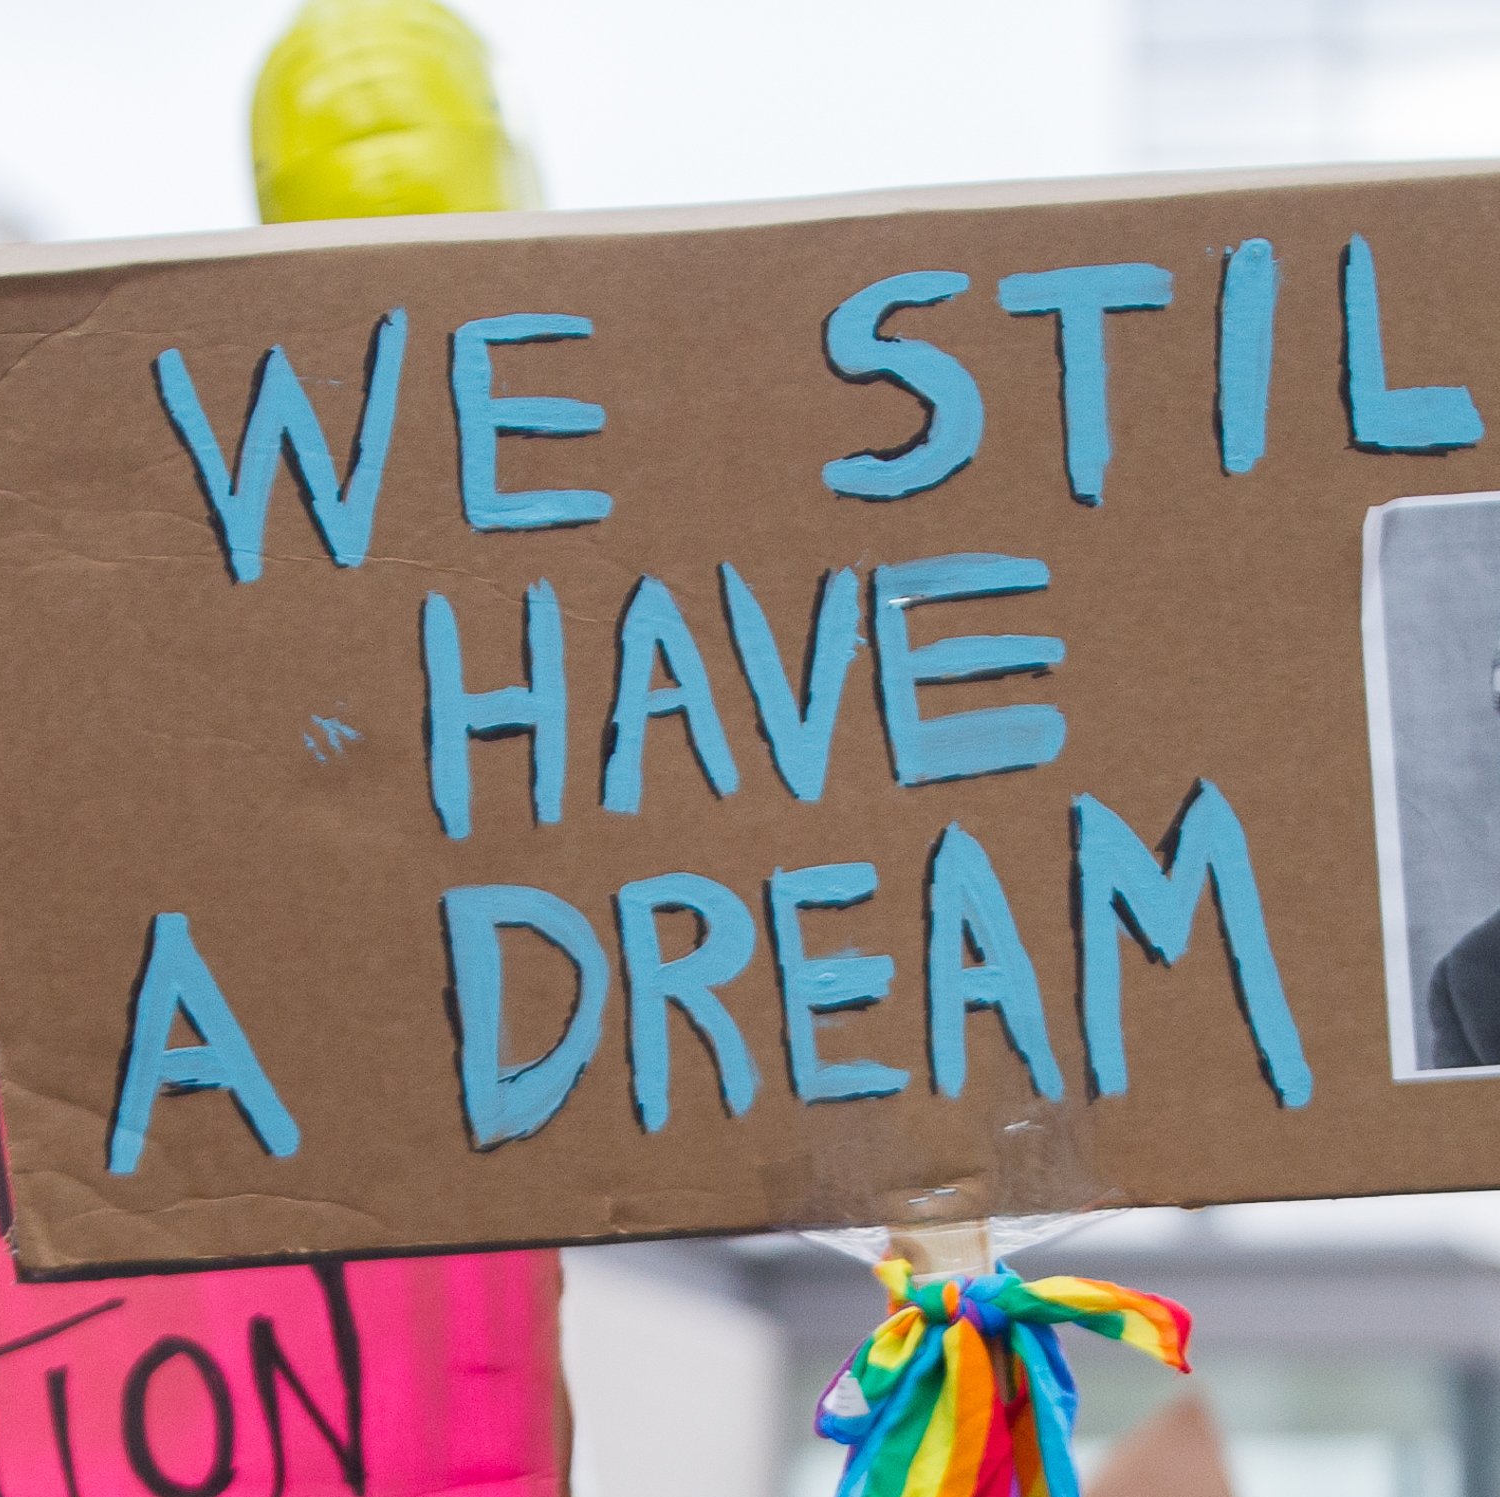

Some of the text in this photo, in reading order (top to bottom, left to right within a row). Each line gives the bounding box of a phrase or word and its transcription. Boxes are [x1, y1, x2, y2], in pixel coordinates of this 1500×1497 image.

[150, 307, 614, 584] WE
[418, 553, 1066, 840] HAVE
[106, 777, 1313, 1175] A DREAM
